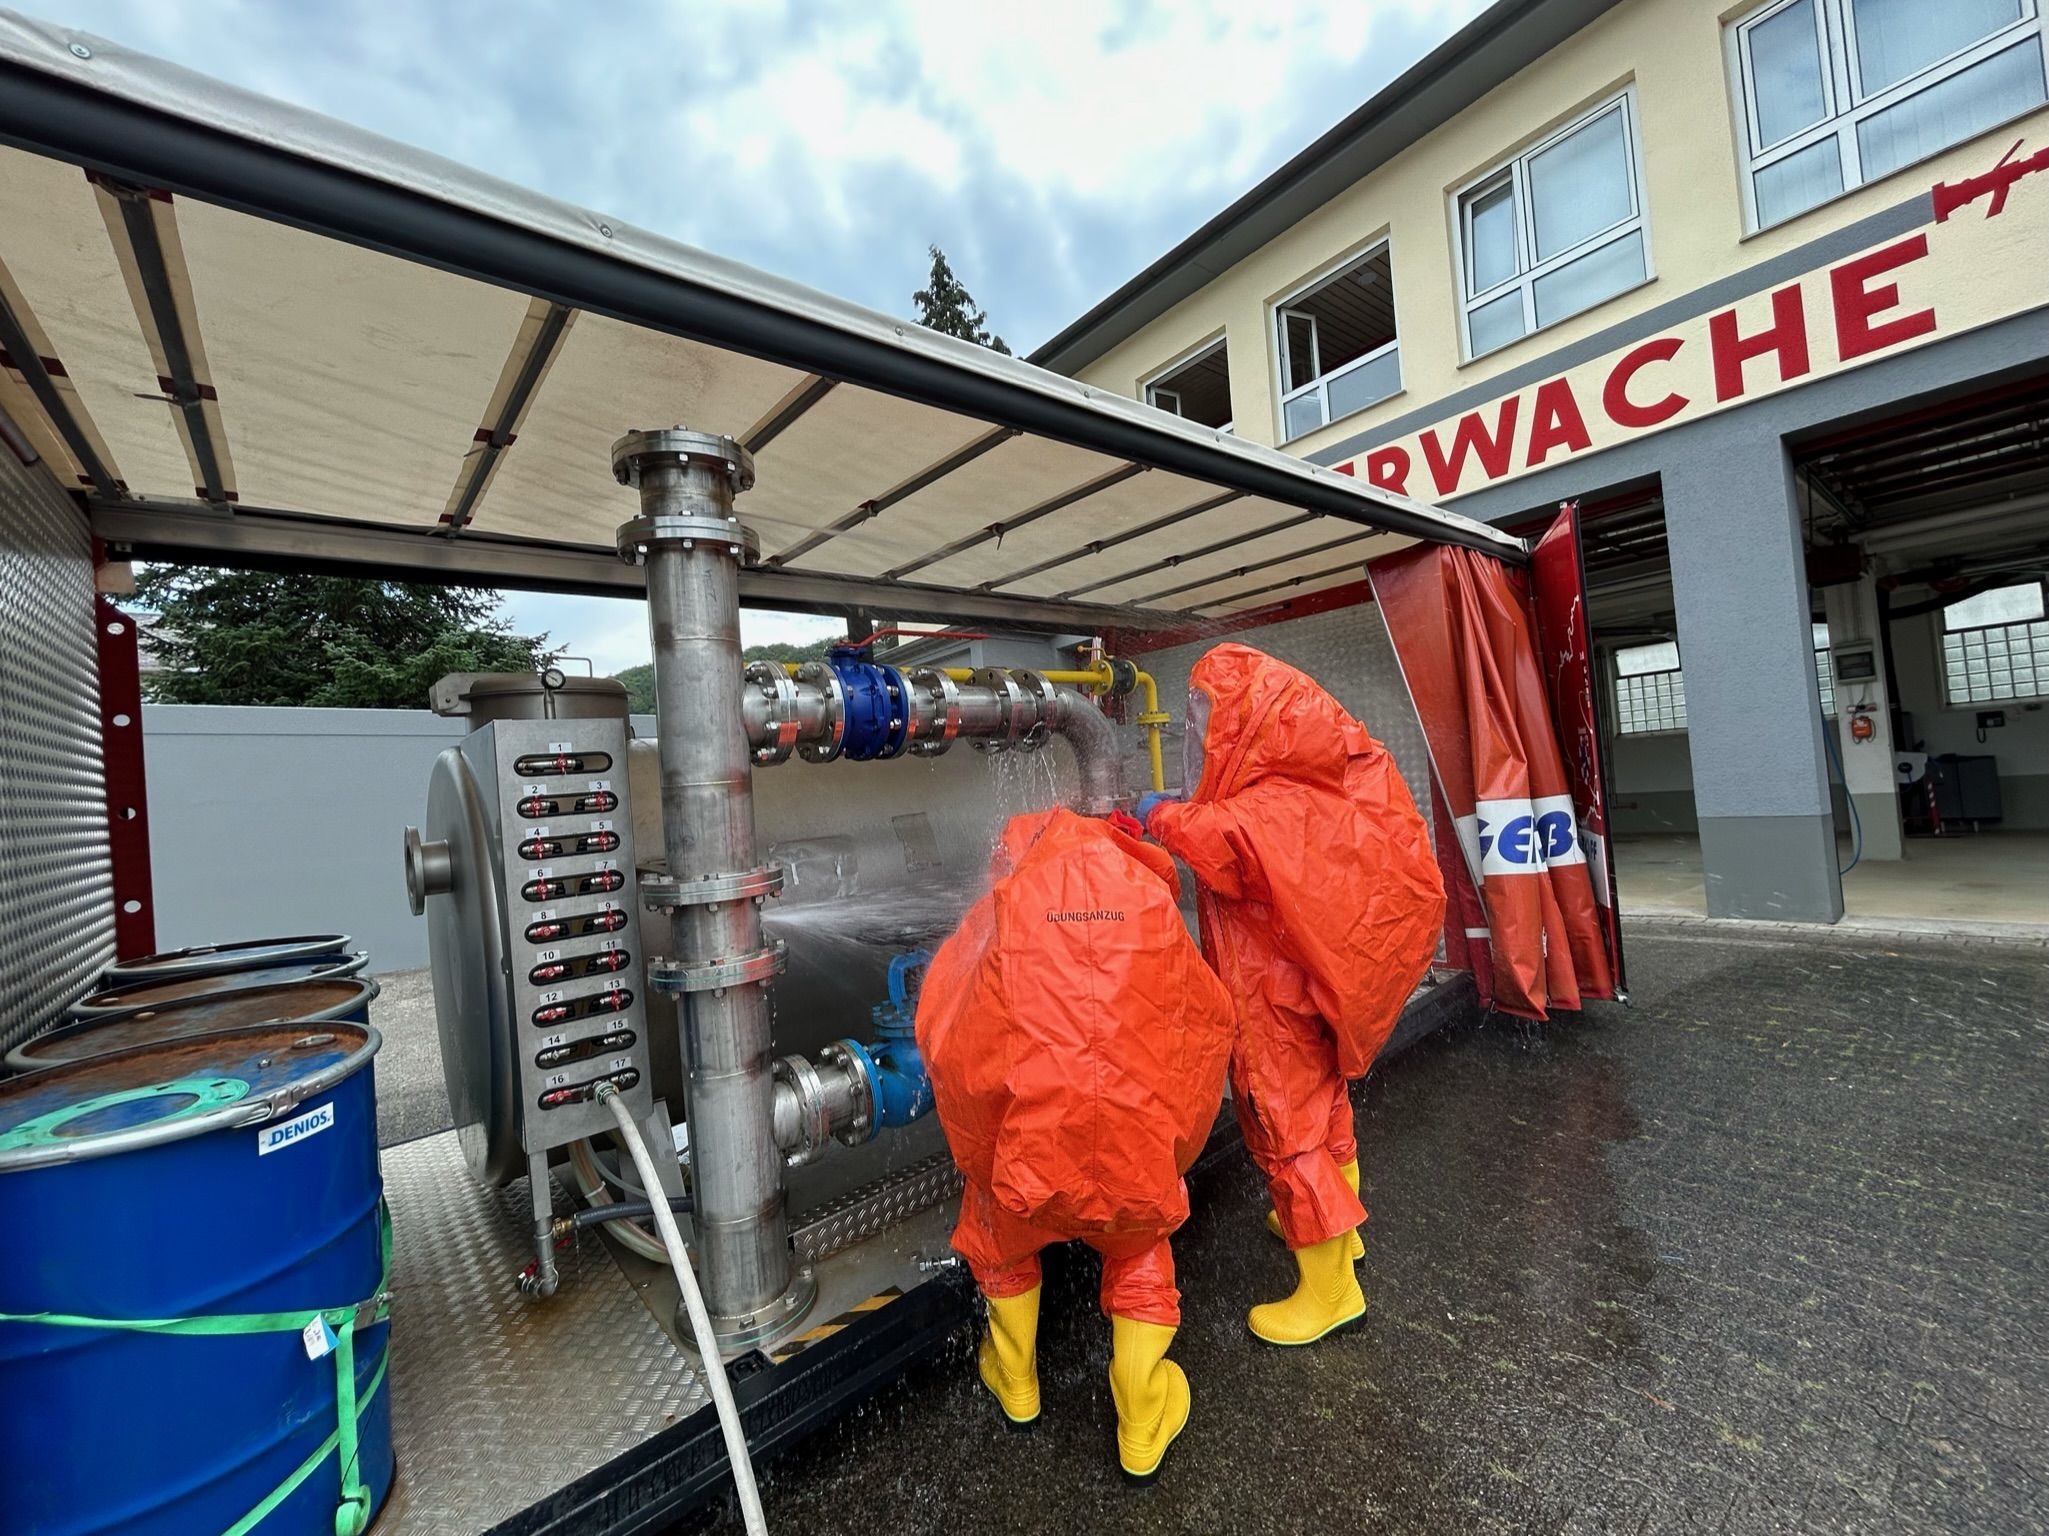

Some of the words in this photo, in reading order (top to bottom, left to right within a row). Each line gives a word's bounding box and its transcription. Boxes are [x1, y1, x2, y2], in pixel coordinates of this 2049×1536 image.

[1332, 233, 1936, 497] RWACHE
[557, 743, 563, 751] 1
[531, 785, 539, 794] 2
[596, 781, 603, 790] 3
[598, 822, 606, 830] 5
[533, 828, 541, 836] 4
[602, 861, 609, 869] 7
[537, 869, 544, 878] 6
[605, 902, 612, 910] 9
[540, 911, 548, 920] 8
[542, 951, 556, 960] 10
[609, 980, 621, 988] 13
[545, 992, 558, 1002] 12
[611, 1020, 624, 1029] 15
[548, 1035, 561, 1045] 14
[614, 1058, 627, 1068] 17
[551, 1074, 565, 1085] 16
